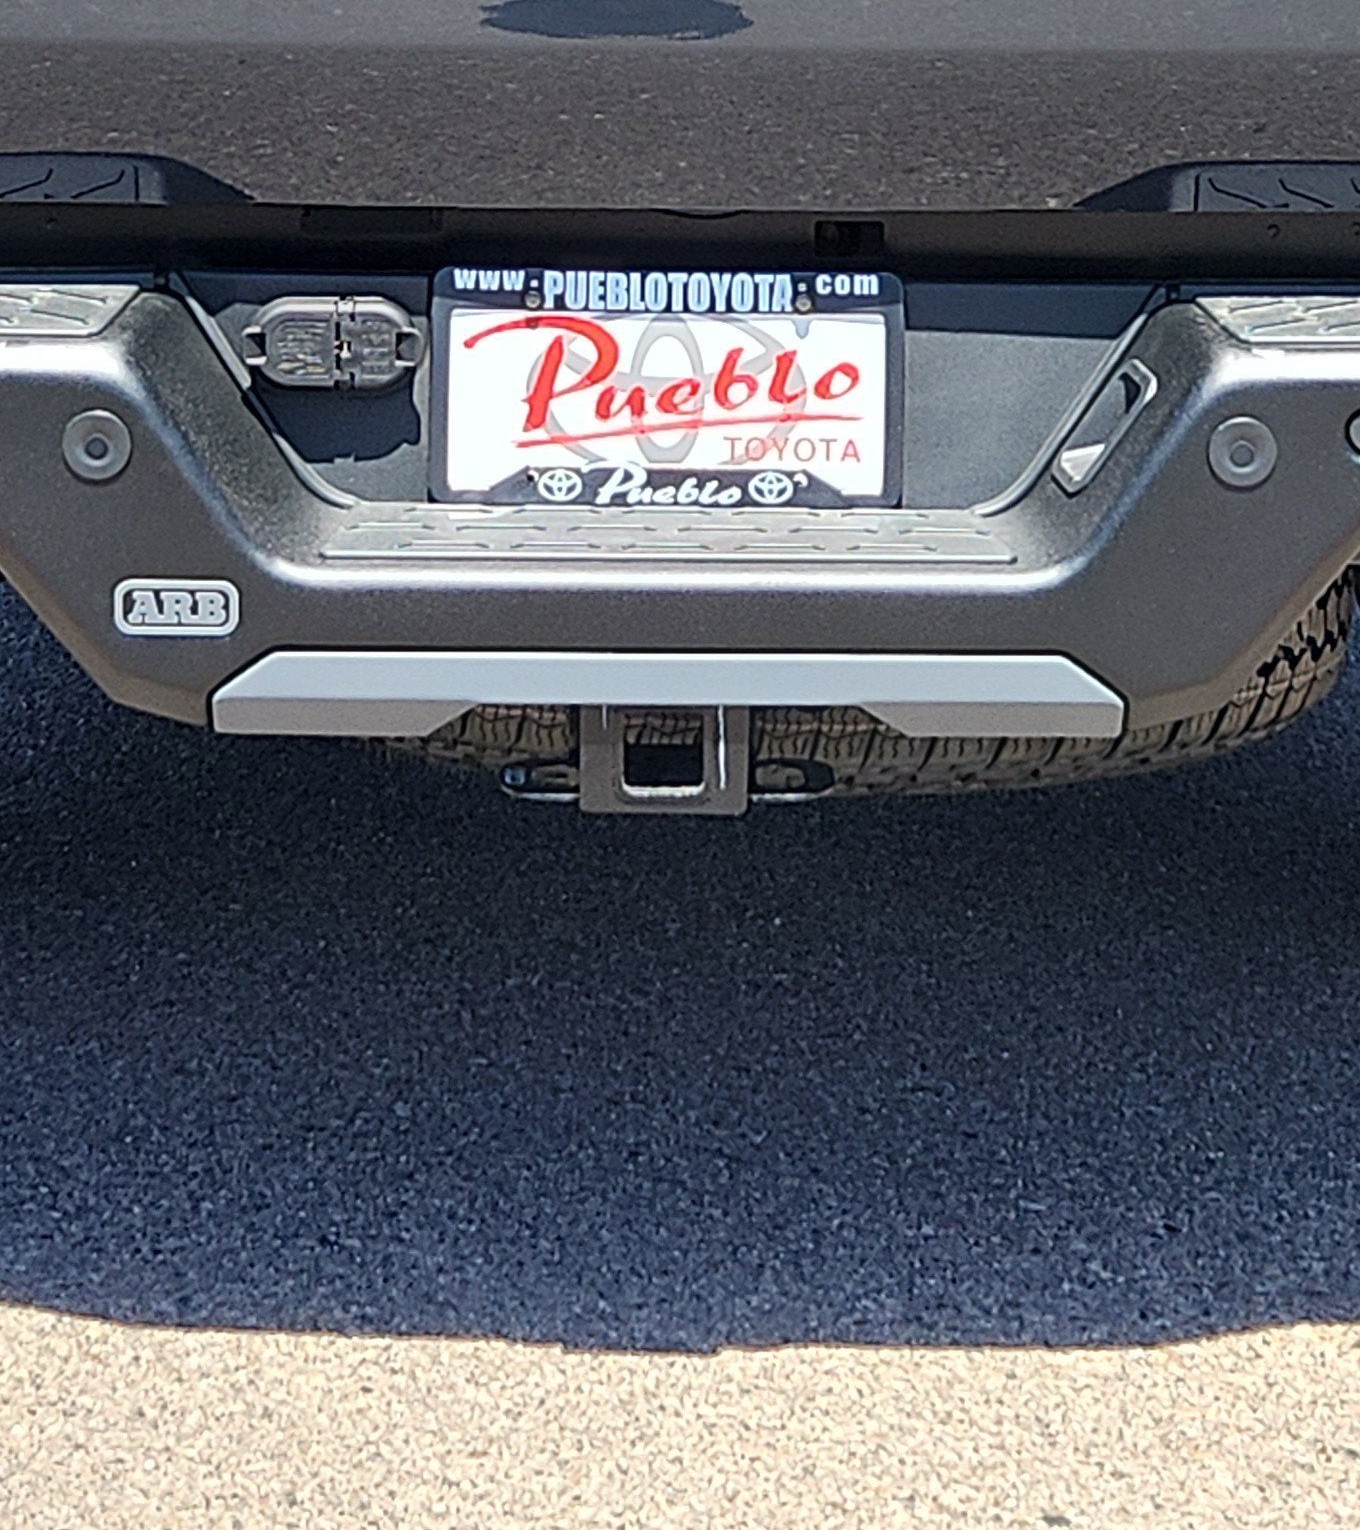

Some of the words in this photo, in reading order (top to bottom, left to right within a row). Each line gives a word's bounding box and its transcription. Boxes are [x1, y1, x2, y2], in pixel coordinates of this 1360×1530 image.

[463, 315, 861, 432] Pueblo
[723, 436, 861, 464] TOYOTA
[581, 461, 743, 505] Pueblo
[127, 590, 227, 624] ARB
